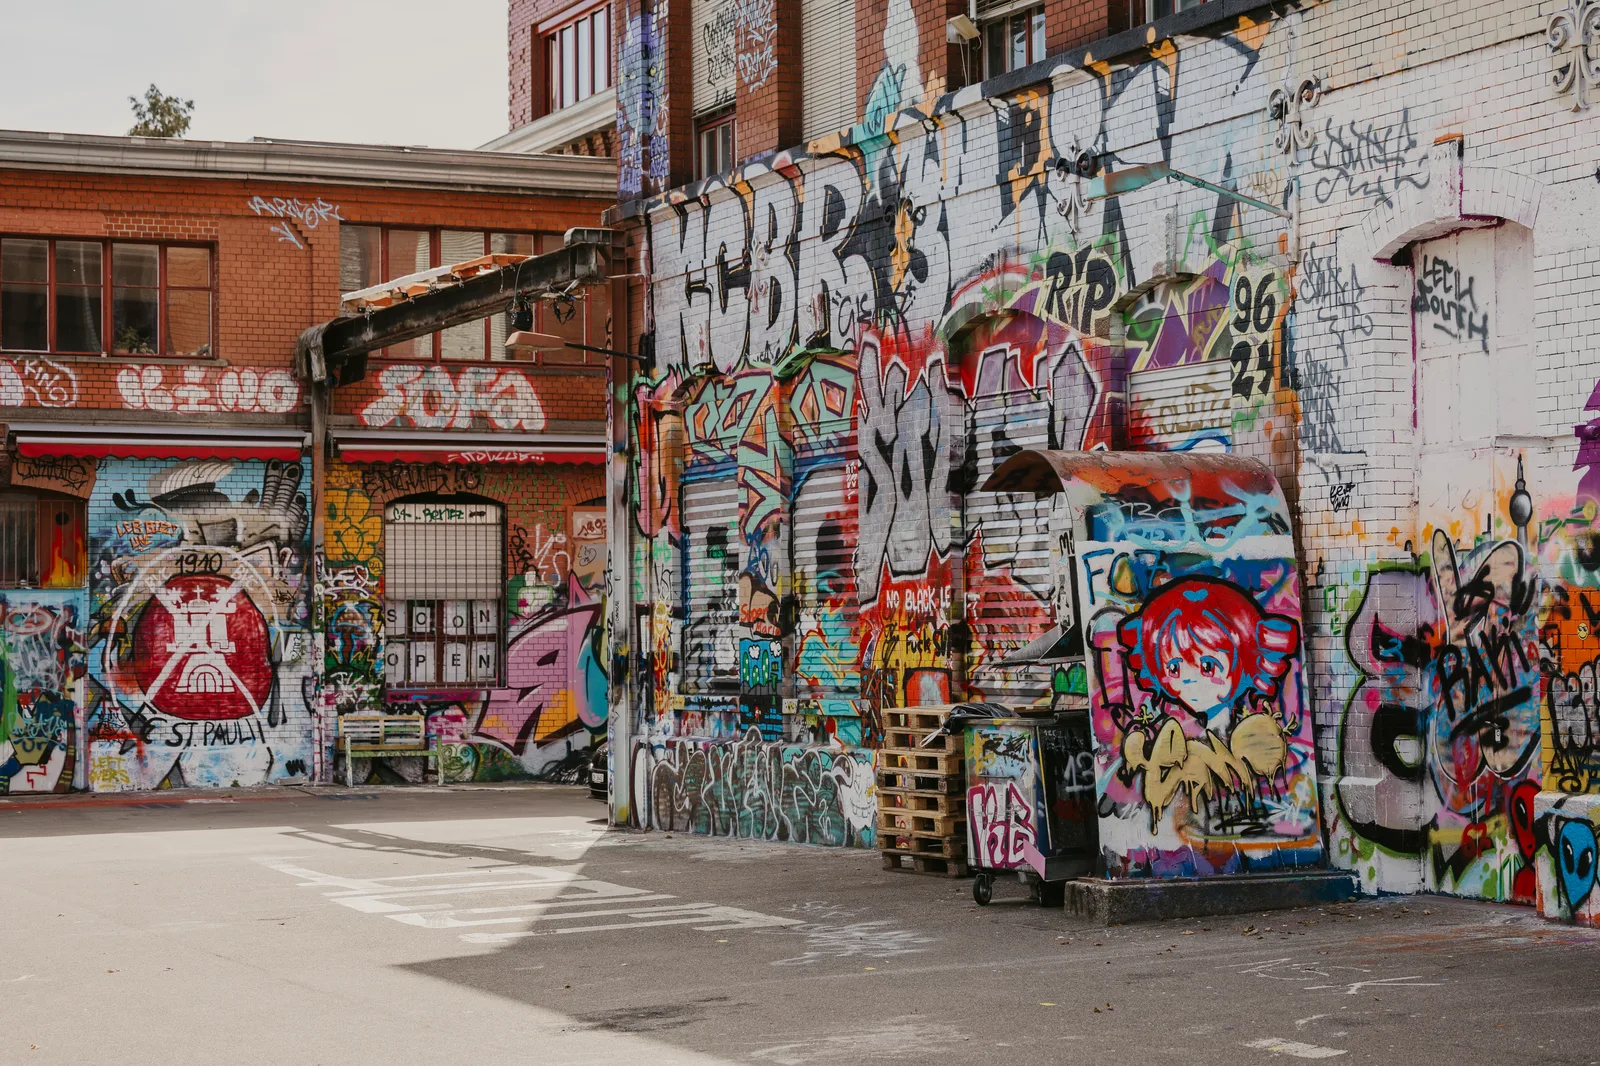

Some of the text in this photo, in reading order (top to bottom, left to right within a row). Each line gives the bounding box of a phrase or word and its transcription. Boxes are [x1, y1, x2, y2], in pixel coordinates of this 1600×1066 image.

[1046, 246, 1118, 336] RIP
[1232, 270, 1277, 333] 96
[360, 364, 548, 431] SOFA
[175, 553, 222, 575] 1910
[886, 589, 900, 609] NO
[905, 587, 936, 612] BLACK
[387, 608, 490, 629] SOON
[387, 653, 491, 669] OPEN
[203, 718, 257, 747] PAULI
[89, 756, 126, 770] LEFT
